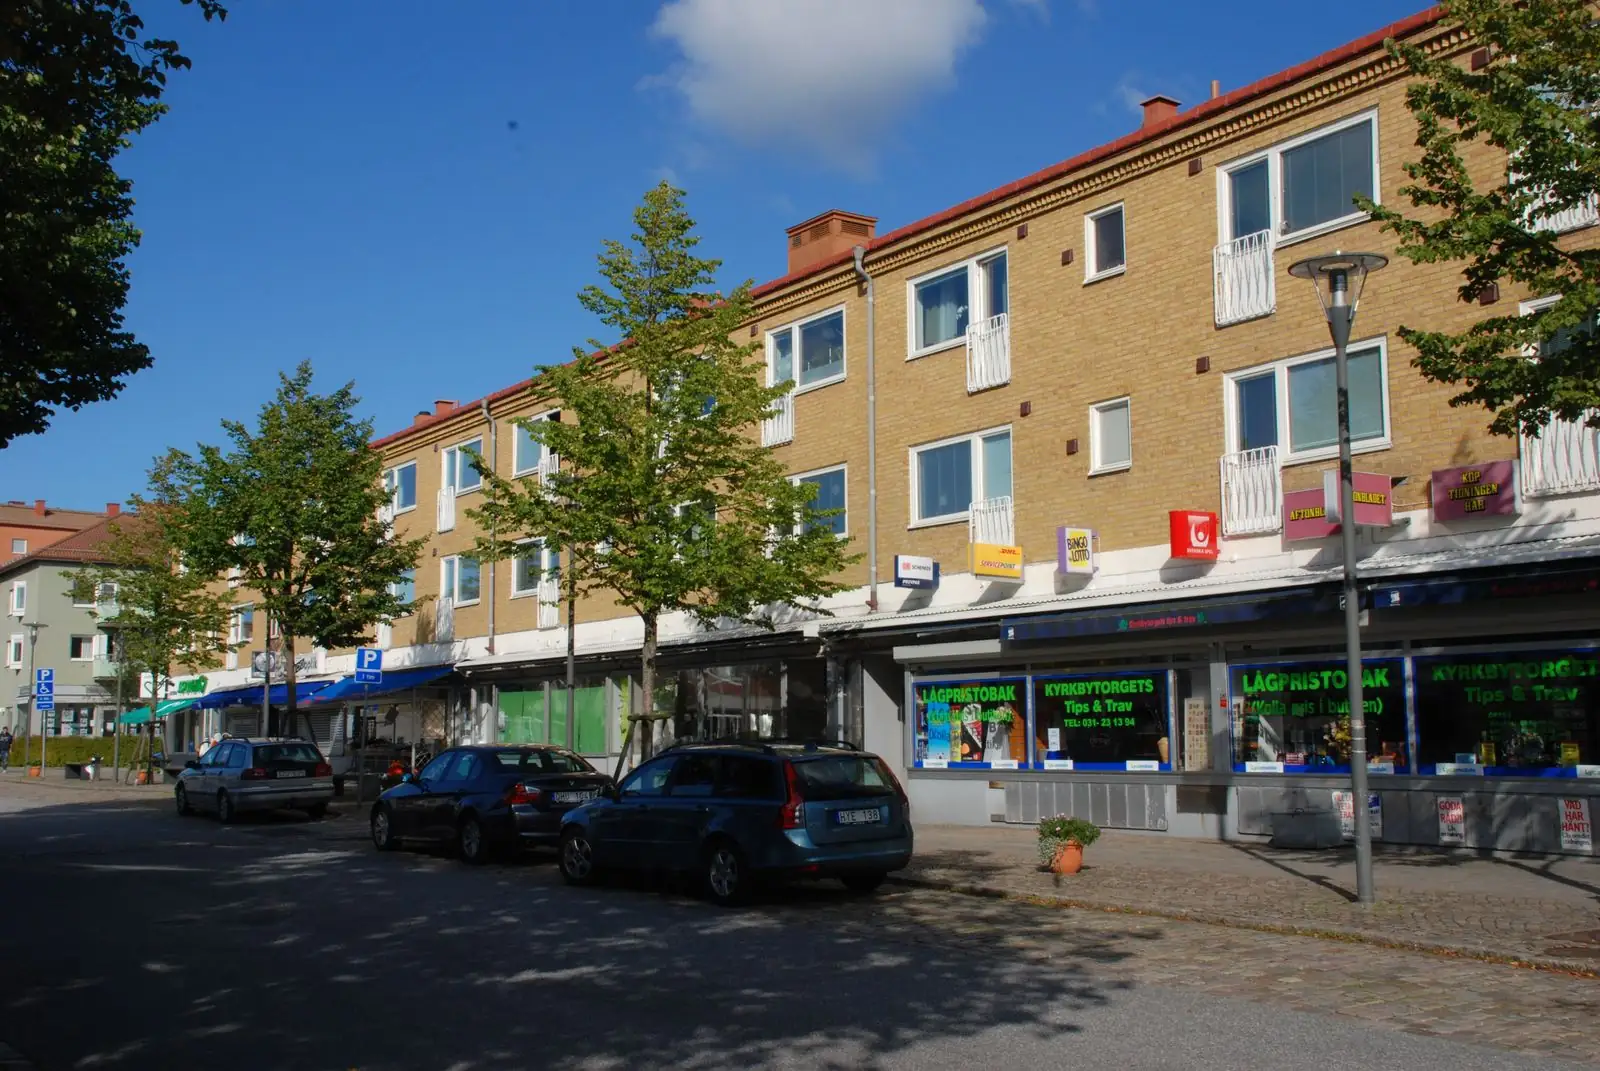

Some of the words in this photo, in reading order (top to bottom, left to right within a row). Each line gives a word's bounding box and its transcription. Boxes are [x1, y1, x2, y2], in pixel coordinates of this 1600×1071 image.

[1352, 491, 1386, 505] ONBLADET
[1072, 548, 1089, 562] LOTTO
[363, 650, 377, 668] P
[41, 669, 50, 680] P
[1431, 659, 1599, 681] KYRKBYTORGET
[1044, 678, 1154, 697] KYRKBYTORGETS
[1242, 668, 1390, 693] LÅGPRISTOAK
[922, 685, 1016, 704] LÅGPRISTOBAK
[1464, 686, 1505, 705] Tips
[1511, 685, 1526, 702] &
[1532, 684, 1579, 701] Trav
[1064, 700, 1089, 715] Tips
[1093, 700, 1102, 713] &
[1104, 698, 1133, 713] Trav
[1328, 697, 1383, 714] buten)
[1064, 719, 1081, 728] TEL:
[1101, 717, 1112, 727] 23
[1113, 718, 1124, 727] 13
[1124, 717, 1135, 727] 94
[1440, 800, 1464, 810] GODA
[1563, 799, 1582, 810] VAD
[839, 810, 857, 822] HYE
[863, 809, 879, 820] 138
